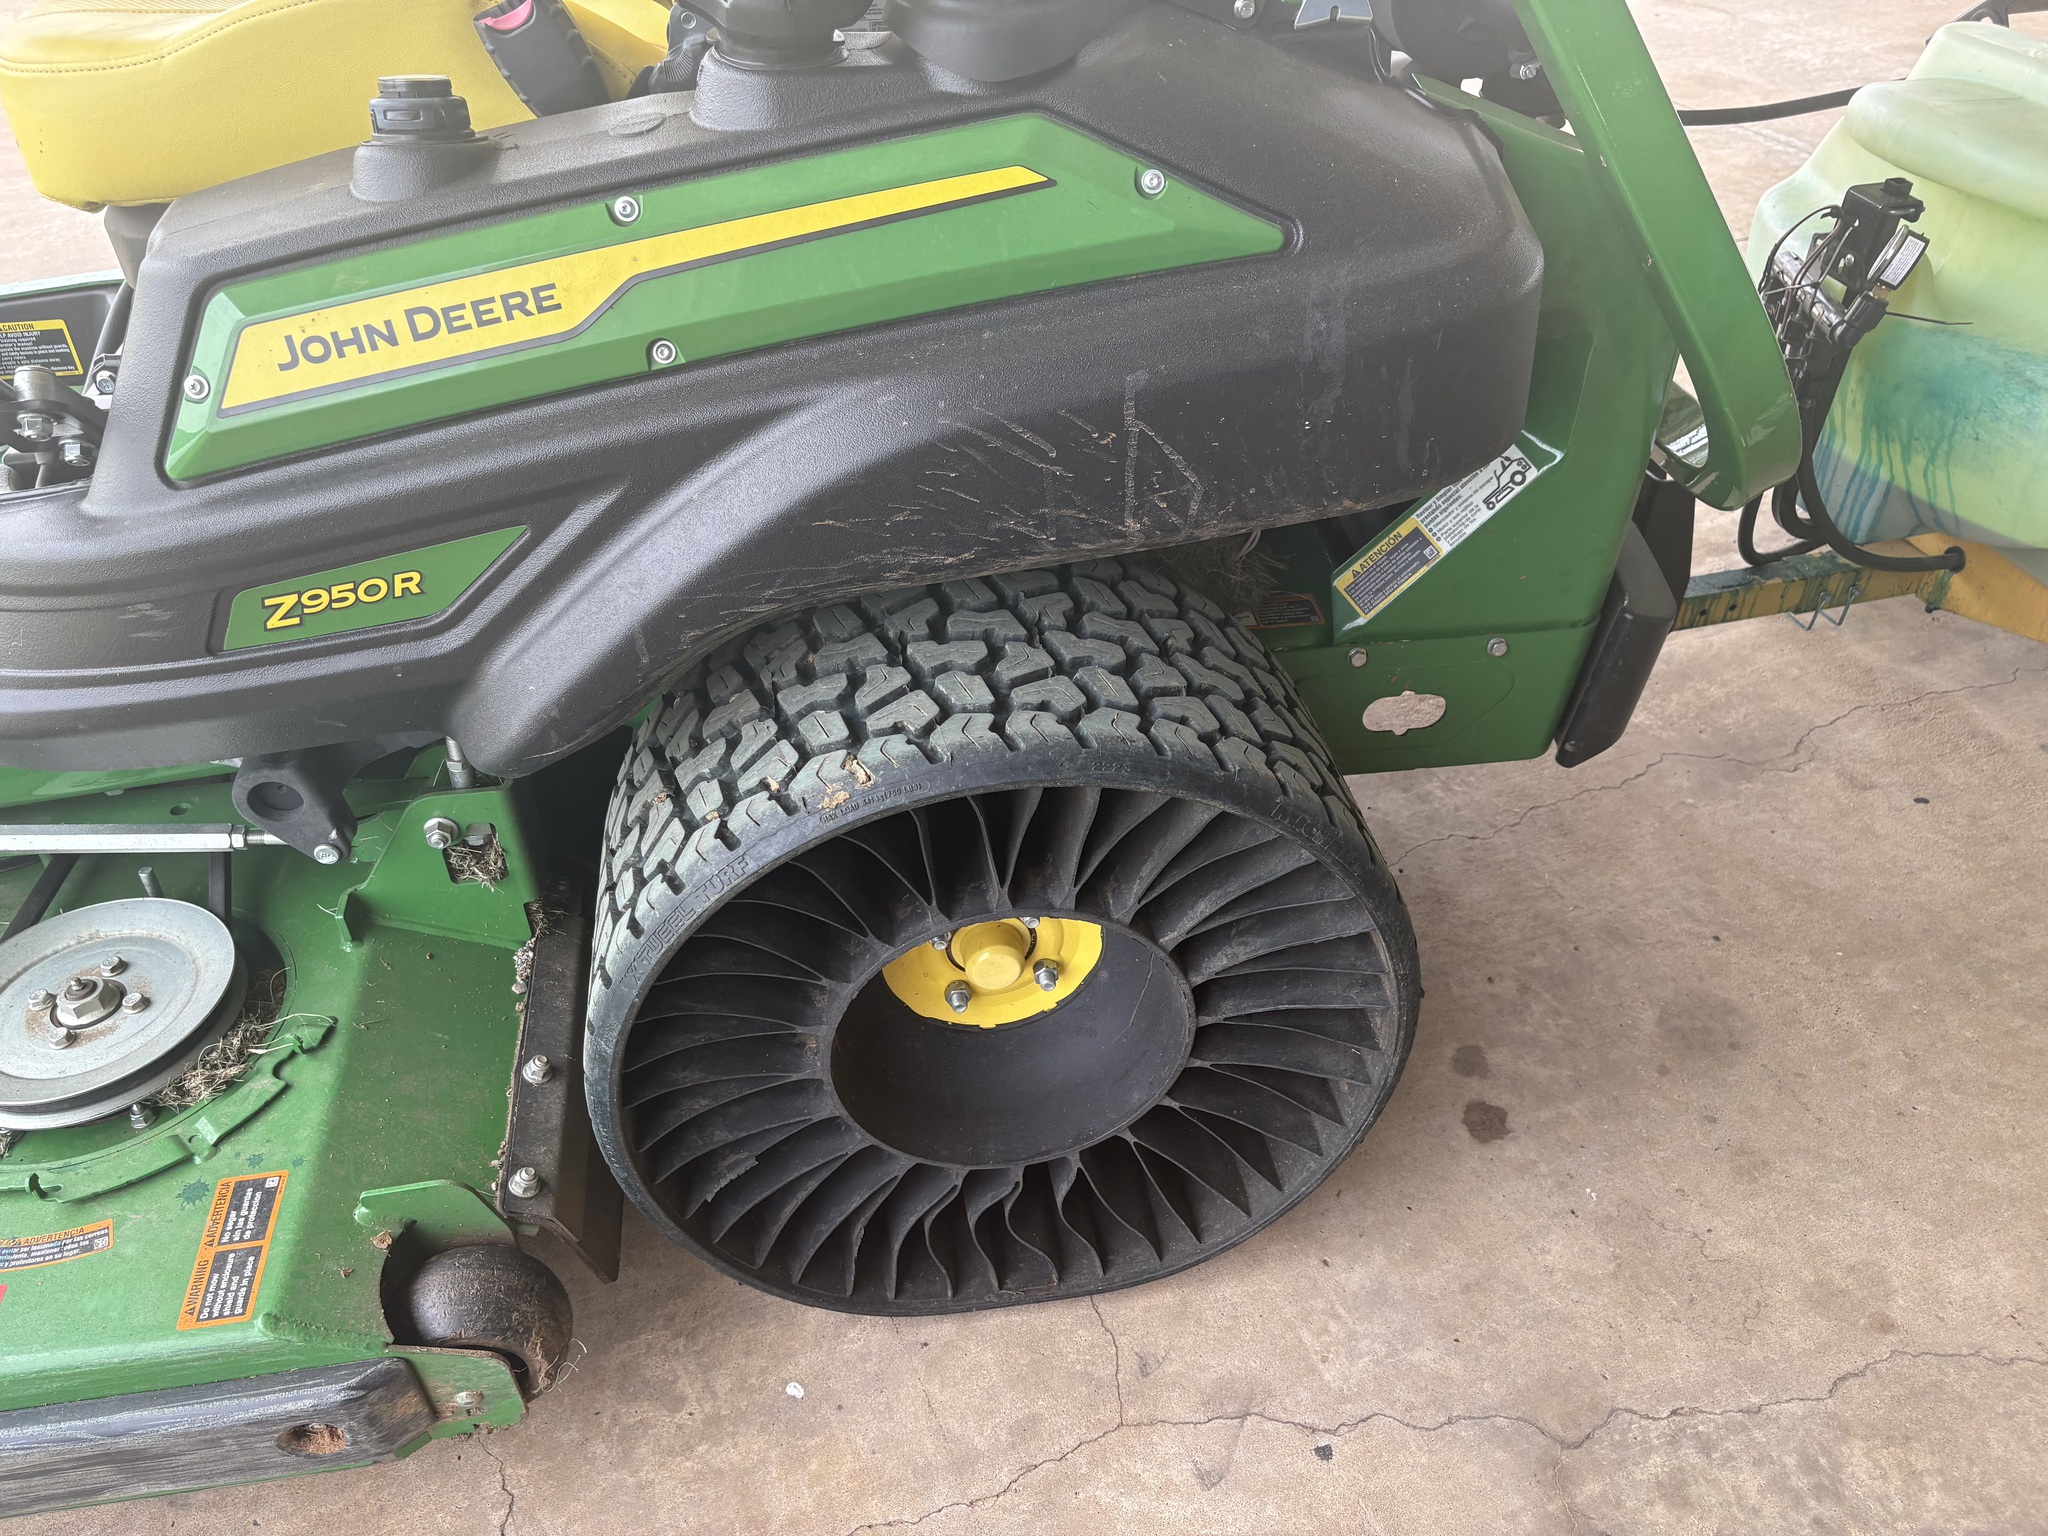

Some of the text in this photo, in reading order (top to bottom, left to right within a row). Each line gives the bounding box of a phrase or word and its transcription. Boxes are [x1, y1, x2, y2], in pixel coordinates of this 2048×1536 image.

[2, 323, 35, 332] CAUTION
[278, 283, 563, 372] JOHN DEERE
[1359, 531, 1403, 571] ATENCIÓN
[263, 571, 423, 630] Z950R
[840, 803, 860, 816] LOAD
[637, 904, 697, 965] TWEEL
[695, 855, 749, 902] TURF
[208, 1181, 232, 1239] ADVERTENCIA
[221, 1210, 237, 1243] No segar
[232, 1227, 240, 1241] sin
[240, 1187, 253, 1216] guardas
[24, 1227, 84, 1245] ADVERTENCIA
[85, 1228, 109, 1239] correas
[243, 1229, 251, 1240] de
[9, 1256, 44, 1267] protectores
[187, 1259, 209, 1309] WARNING
[200, 1273, 220, 1319] Do not mow
[212, 1253, 235, 1318] without enclosure
[223, 1275, 240, 1316] shield and
[234, 1256, 255, 1315] guards in place
